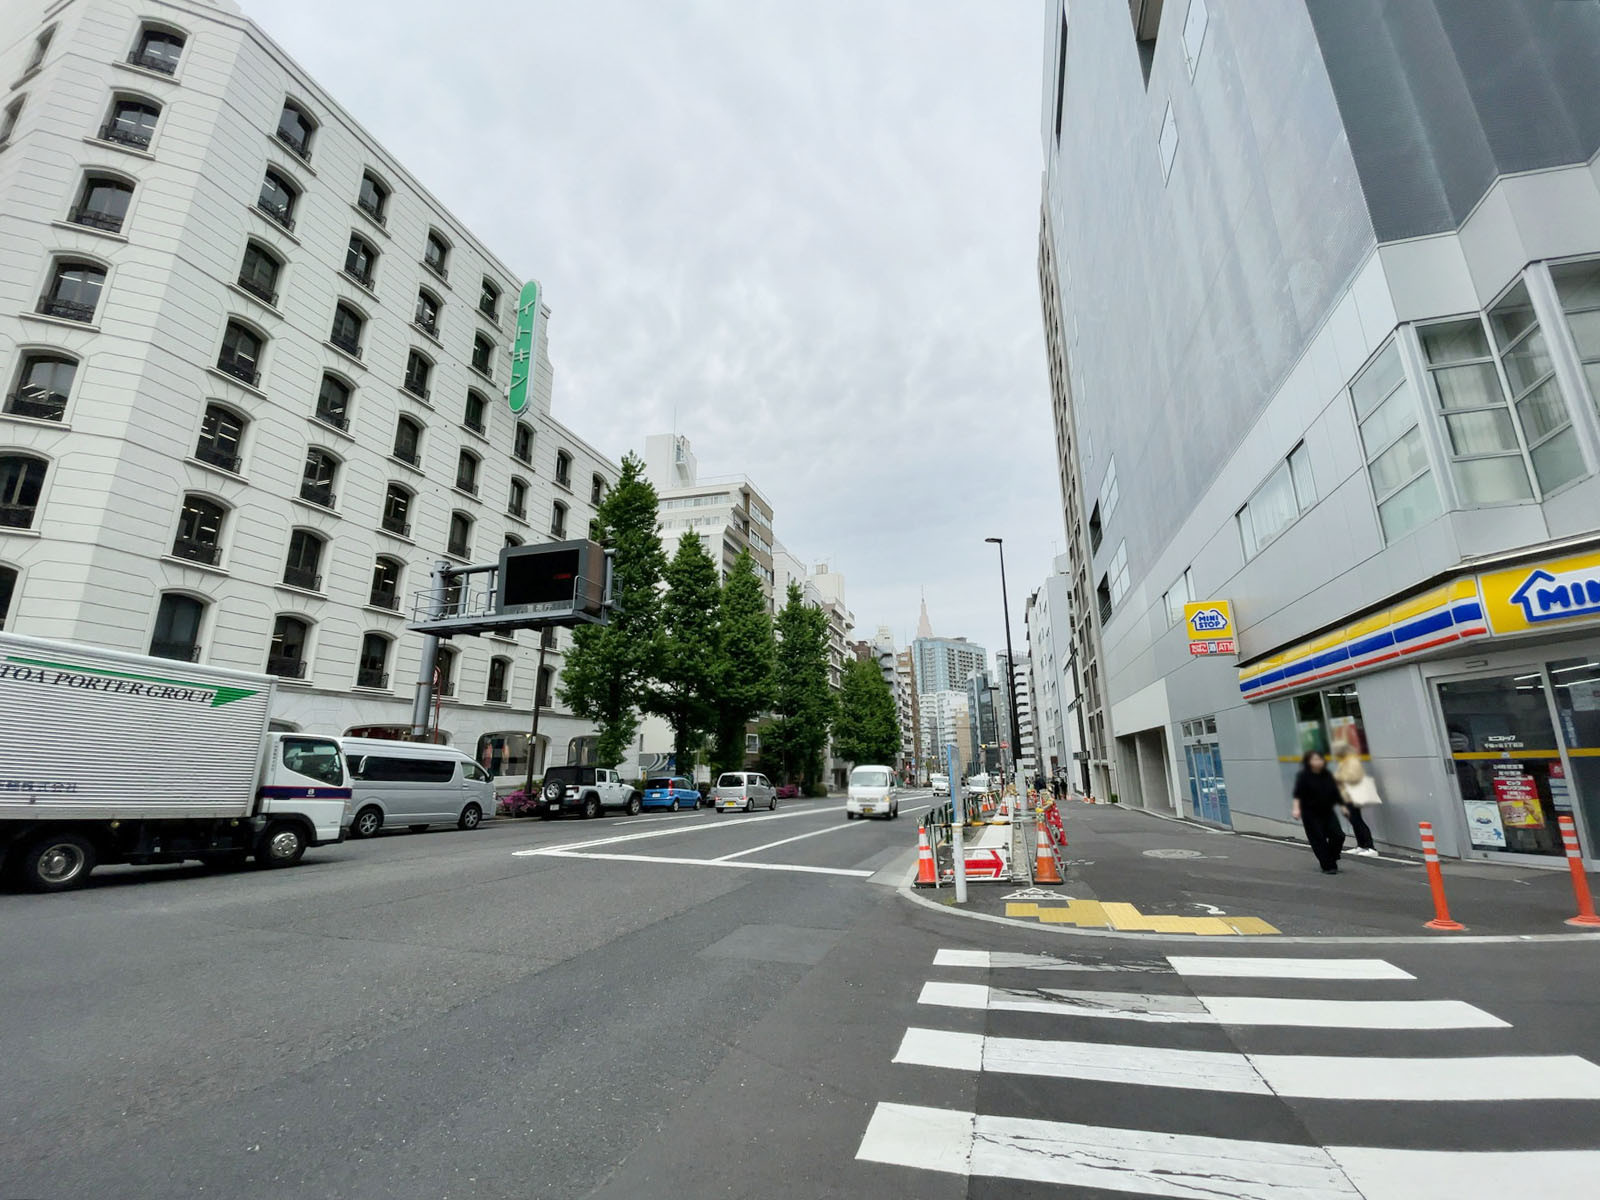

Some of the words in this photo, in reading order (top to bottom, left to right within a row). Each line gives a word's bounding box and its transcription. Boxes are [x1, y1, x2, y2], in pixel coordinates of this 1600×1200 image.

[509, 299, 536, 390] イトキン
[1218, 642, 1234, 652] ATM
[0, 664, 46, 684] TOA
[53, 671, 145, 696] PORTER
[146, 684, 214, 703] GROUP
